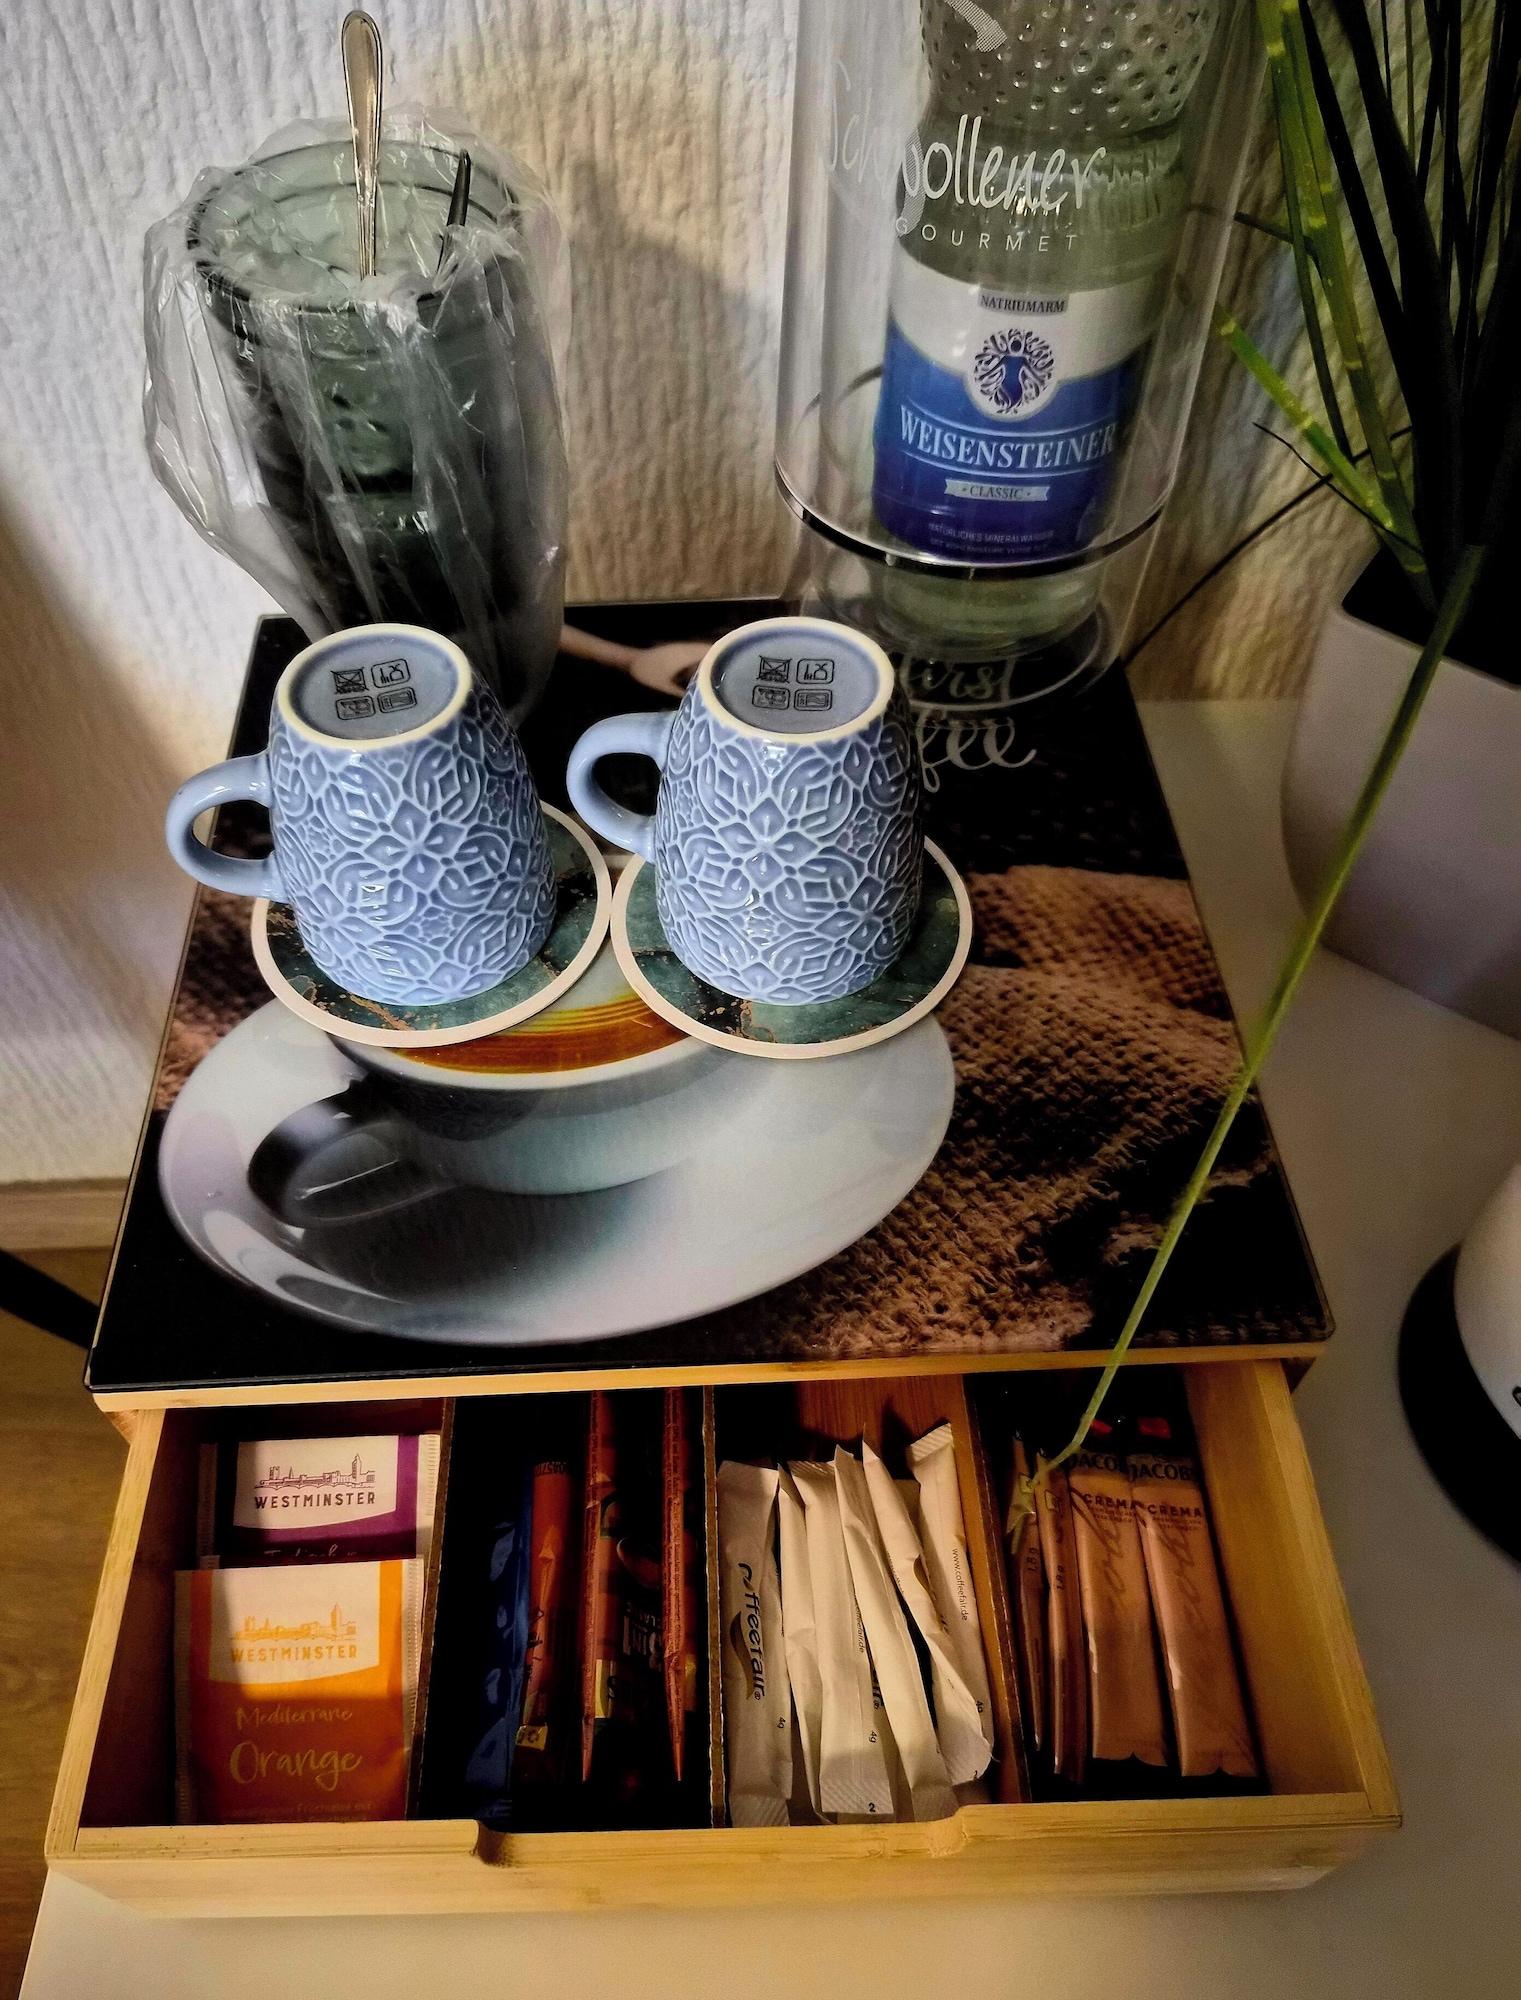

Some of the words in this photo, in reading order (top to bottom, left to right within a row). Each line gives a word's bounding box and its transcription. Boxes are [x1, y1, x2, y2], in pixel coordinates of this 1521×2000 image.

[896, 217, 1078, 252] GOURMET
[980, 294, 1066, 313] NATRIUMARM
[900, 405, 1117, 469] WEISENSTEINER
[969, 485, 1024, 499] CLASSIC
[254, 1491, 376, 1510] WESTMINSTER
[1147, 1504, 1203, 1519] CREMA
[952, 1547, 968, 1622] www.coffeefair.de
[231, 1643, 358, 1663] WESTMINSTER
[229, 1740, 362, 1792] Orange
[868, 1802, 877, 1813] 2
